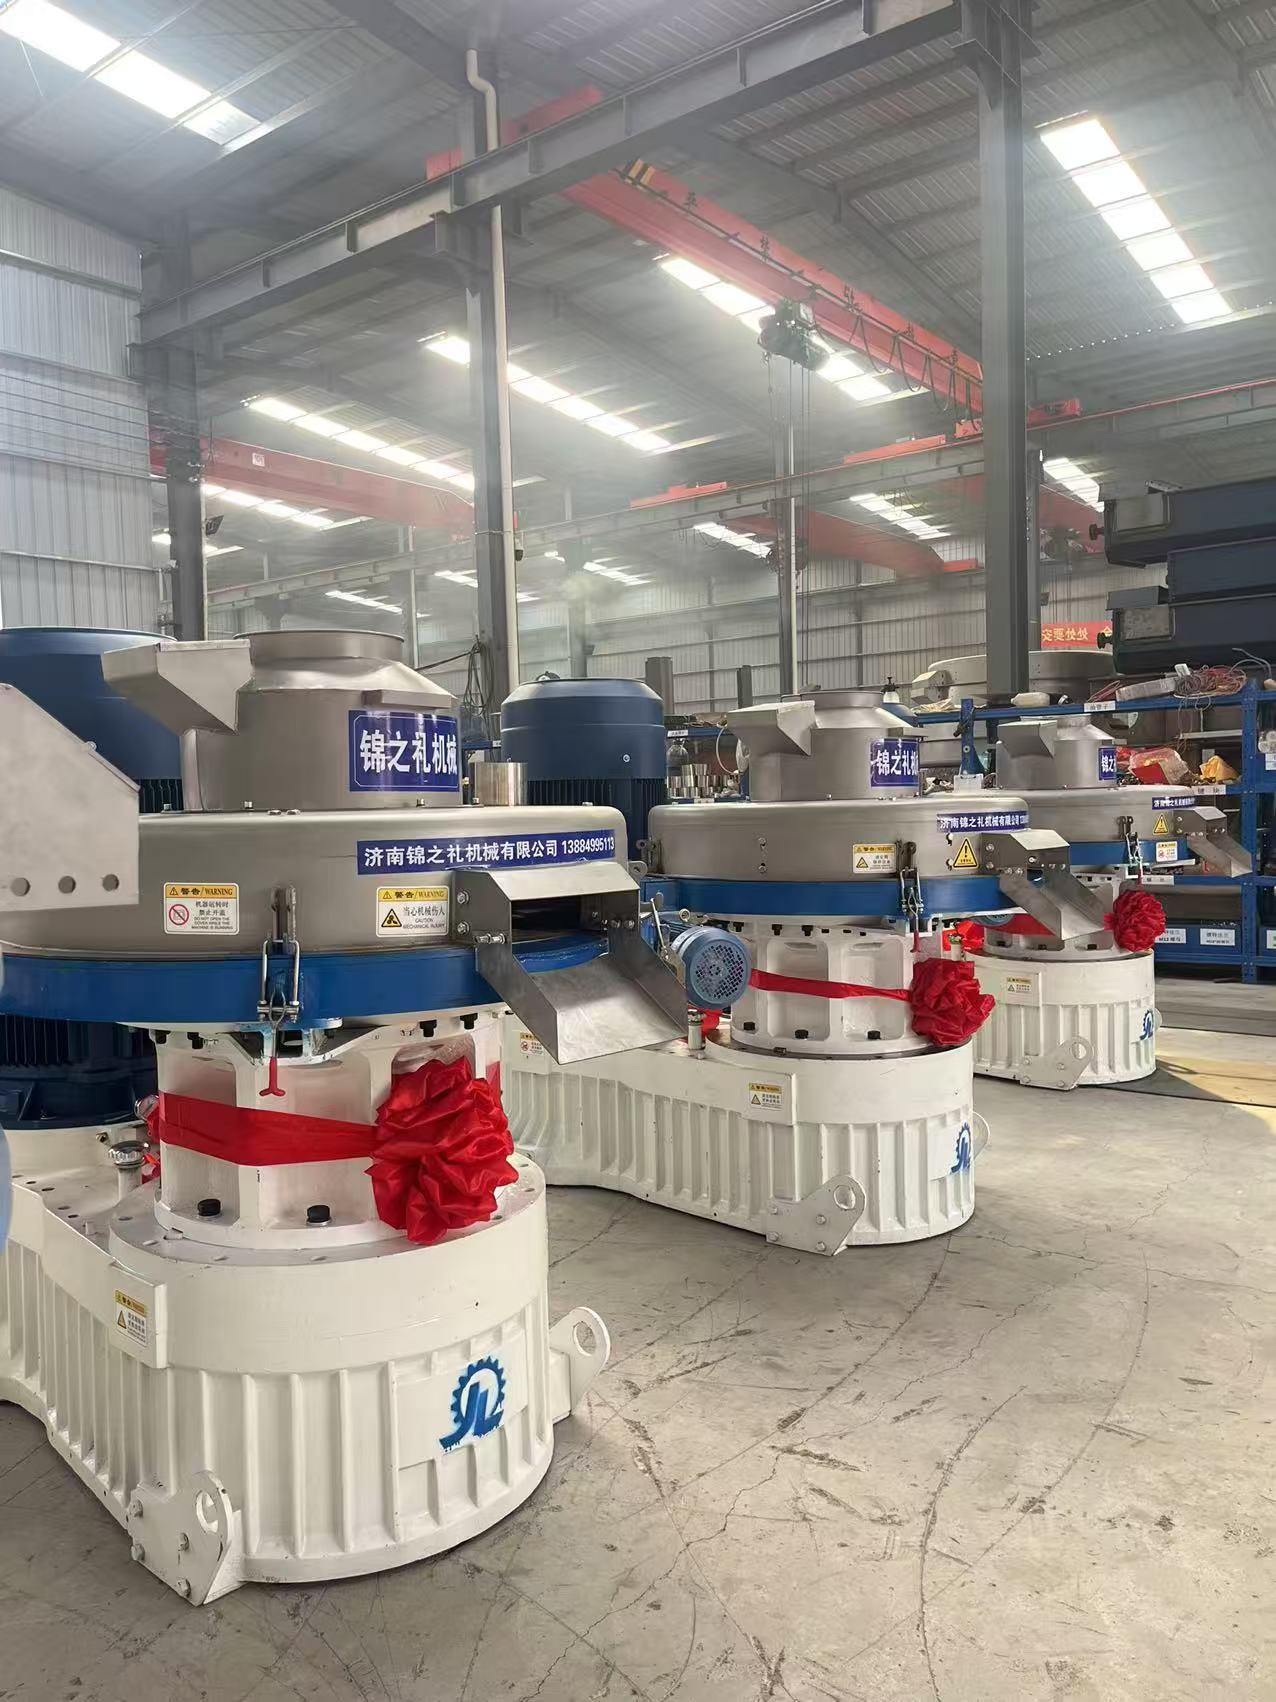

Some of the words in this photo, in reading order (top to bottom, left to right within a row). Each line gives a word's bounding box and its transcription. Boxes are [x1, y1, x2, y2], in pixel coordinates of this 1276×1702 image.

[360, 729, 457, 775] 锦之礼机械
[364, 839, 558, 867] 济南锦之礼机械有限公司
[561, 836, 615, 854] 13884995113
